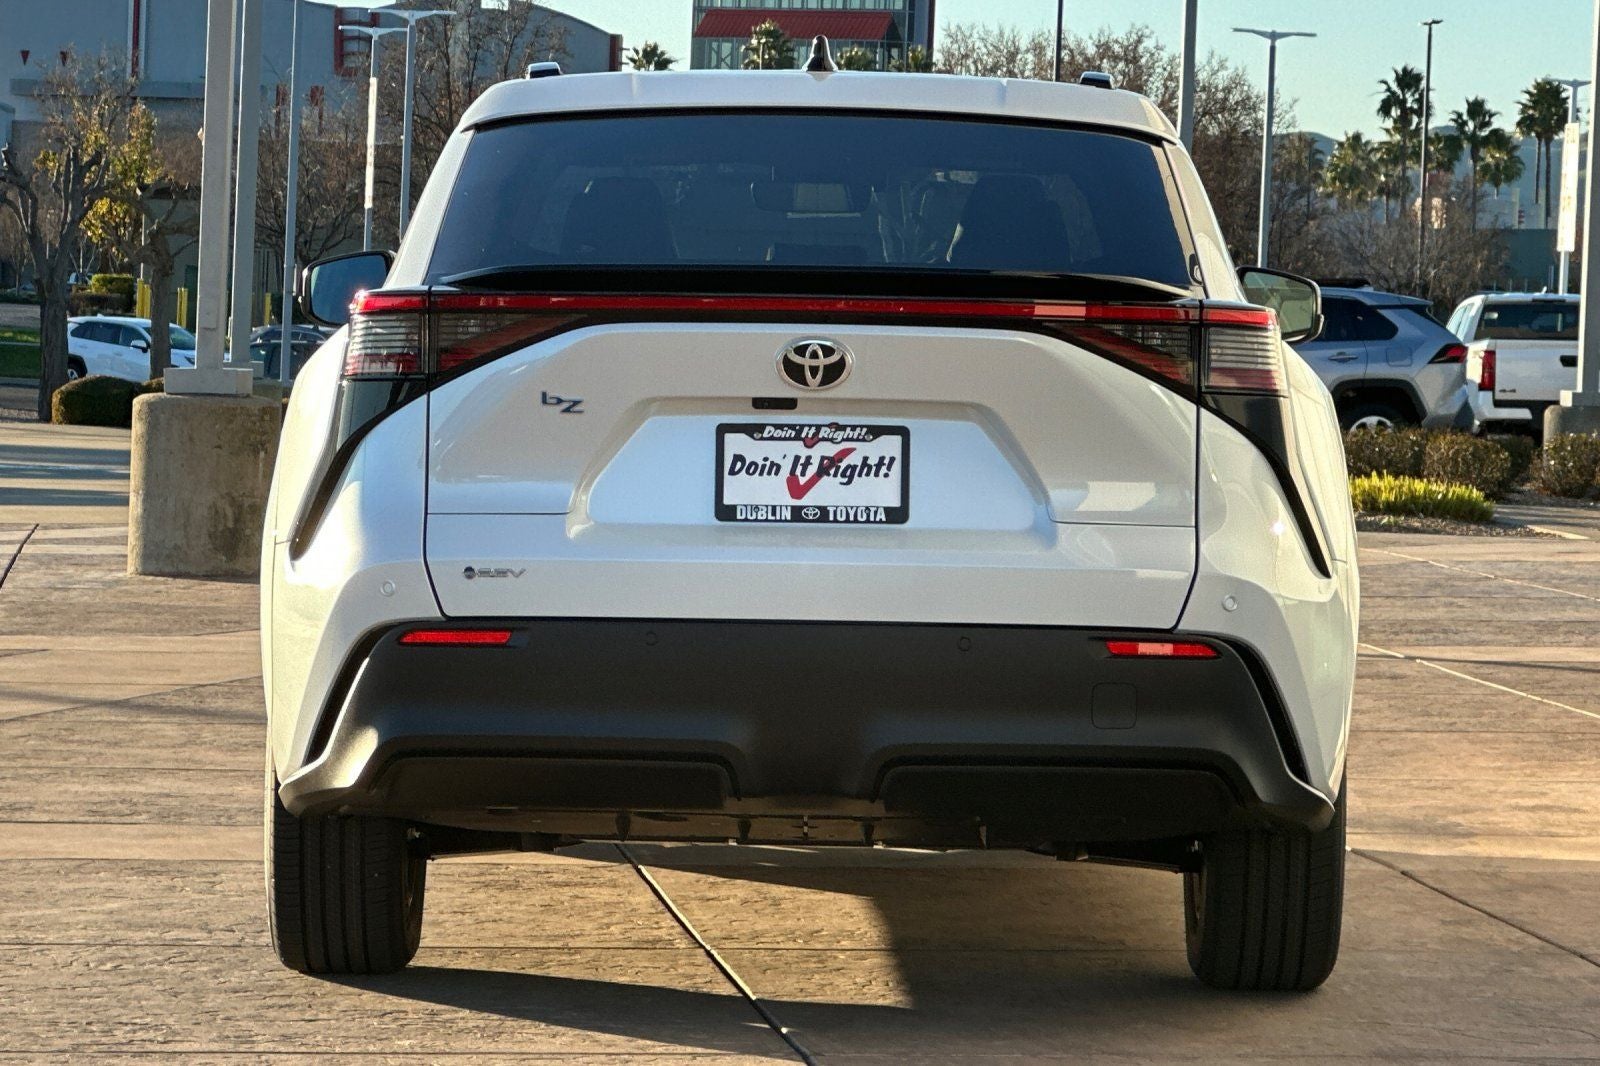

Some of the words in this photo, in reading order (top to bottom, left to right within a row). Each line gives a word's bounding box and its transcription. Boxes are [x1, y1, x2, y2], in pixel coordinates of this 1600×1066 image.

[762, 425, 799, 438] Doin'
[801, 426, 817, 438] It
[819, 426, 867, 443] Right!
[728, 453, 787, 477] Doin'
[789, 454, 812, 477] It
[816, 455, 897, 485] Right!
[736, 504, 792, 521] DUBLIN
[827, 506, 886, 522] TOYOTA
